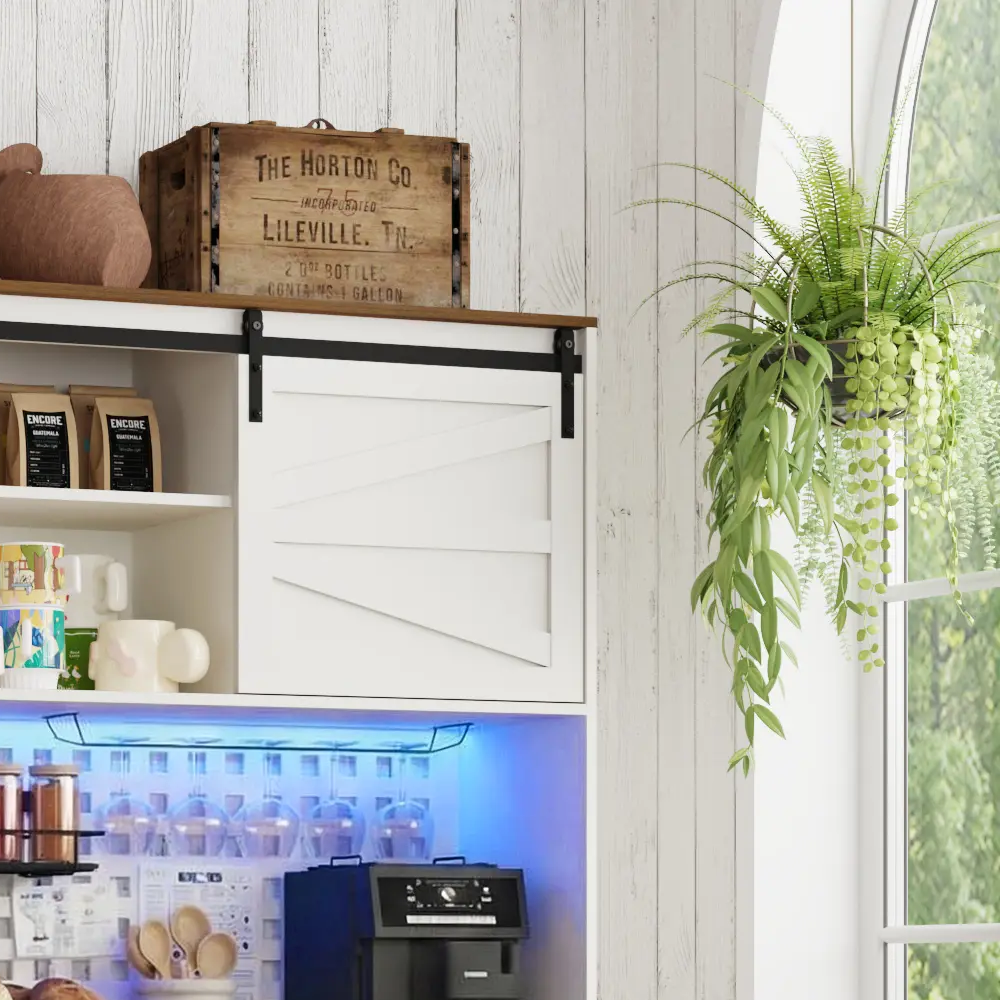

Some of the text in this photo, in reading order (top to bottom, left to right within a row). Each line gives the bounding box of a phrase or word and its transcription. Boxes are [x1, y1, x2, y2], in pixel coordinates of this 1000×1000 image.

[255, 154, 291, 182] THE
[301, 149, 378, 180] HORTON
[325, 263, 387, 282] BOTTLES
[353, 287, 403, 303] GALLON
[27, 414, 63, 426] ENCORE
[110, 419, 146, 430] ENCORE
